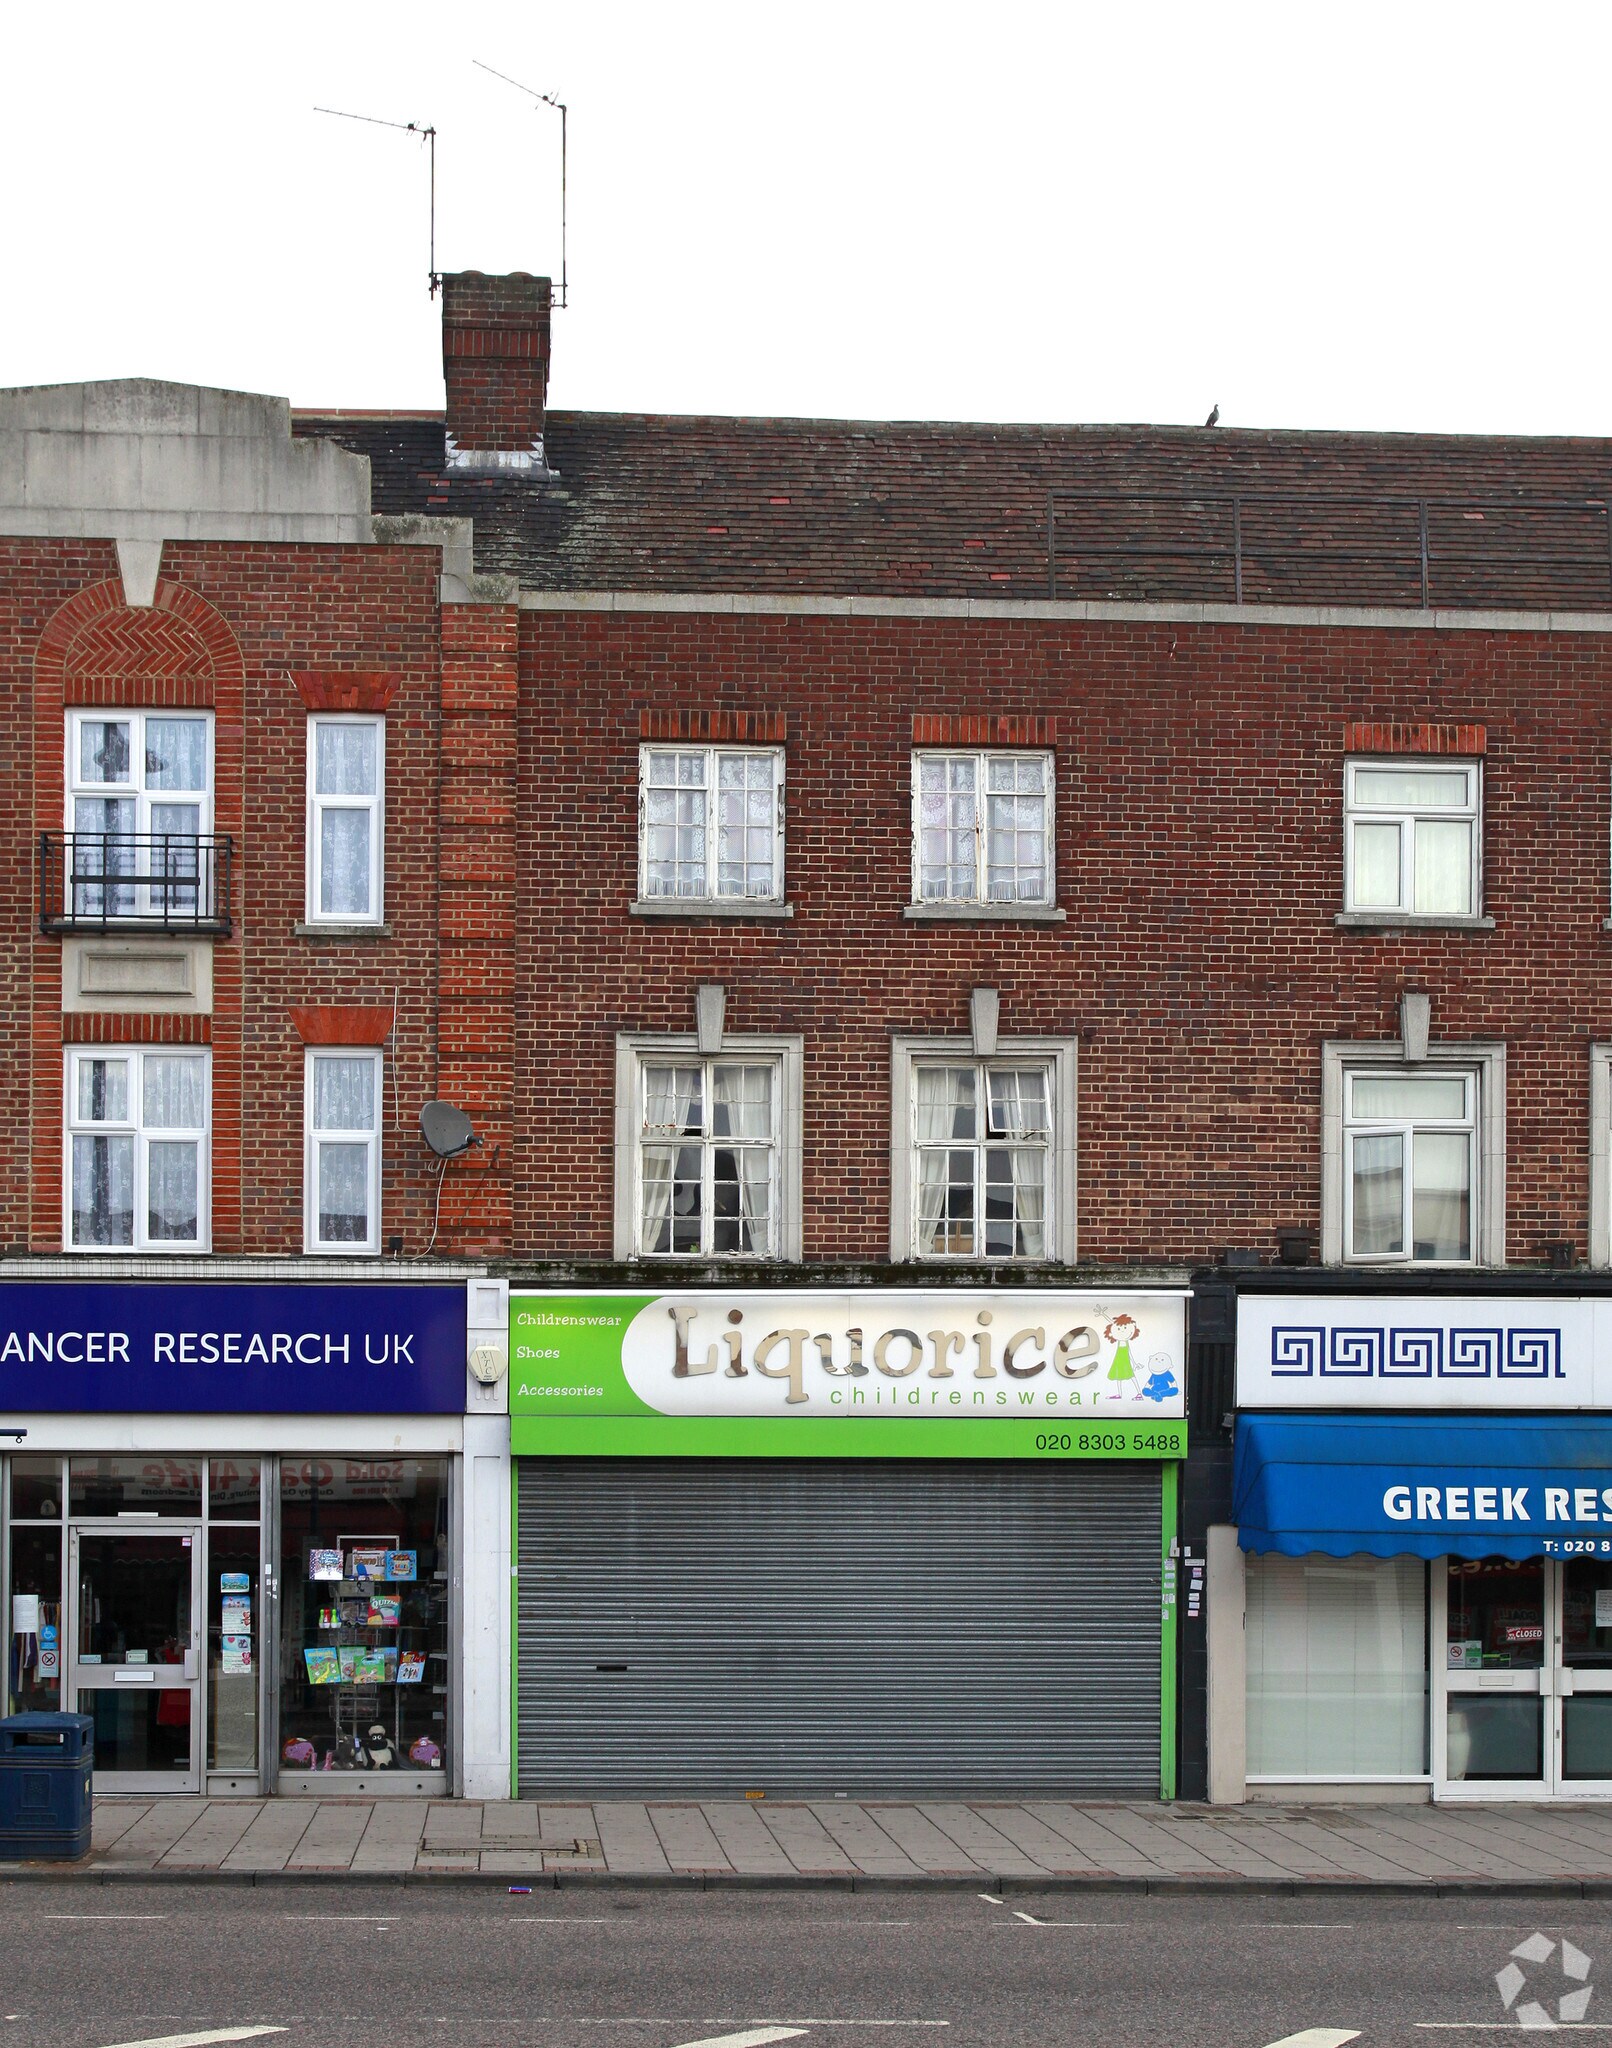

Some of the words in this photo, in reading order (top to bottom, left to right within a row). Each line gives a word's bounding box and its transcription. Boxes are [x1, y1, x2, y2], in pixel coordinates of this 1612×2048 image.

[517, 1312, 622, 1326] Childrenswear
[0, 1332, 130, 1363] ANCER
[154, 1332, 349, 1364] RESEARCH
[365, 1334, 414, 1364] UK
[516, 1345, 560, 1359] Shoes
[668, 1308, 1100, 1405] Liquorice
[517, 1383, 604, 1397] Accessories
[831, 1386, 1100, 1405] childrenswear
[1036, 1434, 1071, 1450] 020
[1078, 1434, 1126, 1450] 8303
[1133, 1434, 1180, 1450] 5488
[1383, 1486, 1531, 1521] GREEK
[1543, 1541, 1558, 1552] T:
[1564, 1541, 1595, 1552] 020
[1601, 1541, 1611, 1552] 8
[1515, 1630, 1542, 1638] CLOSED
